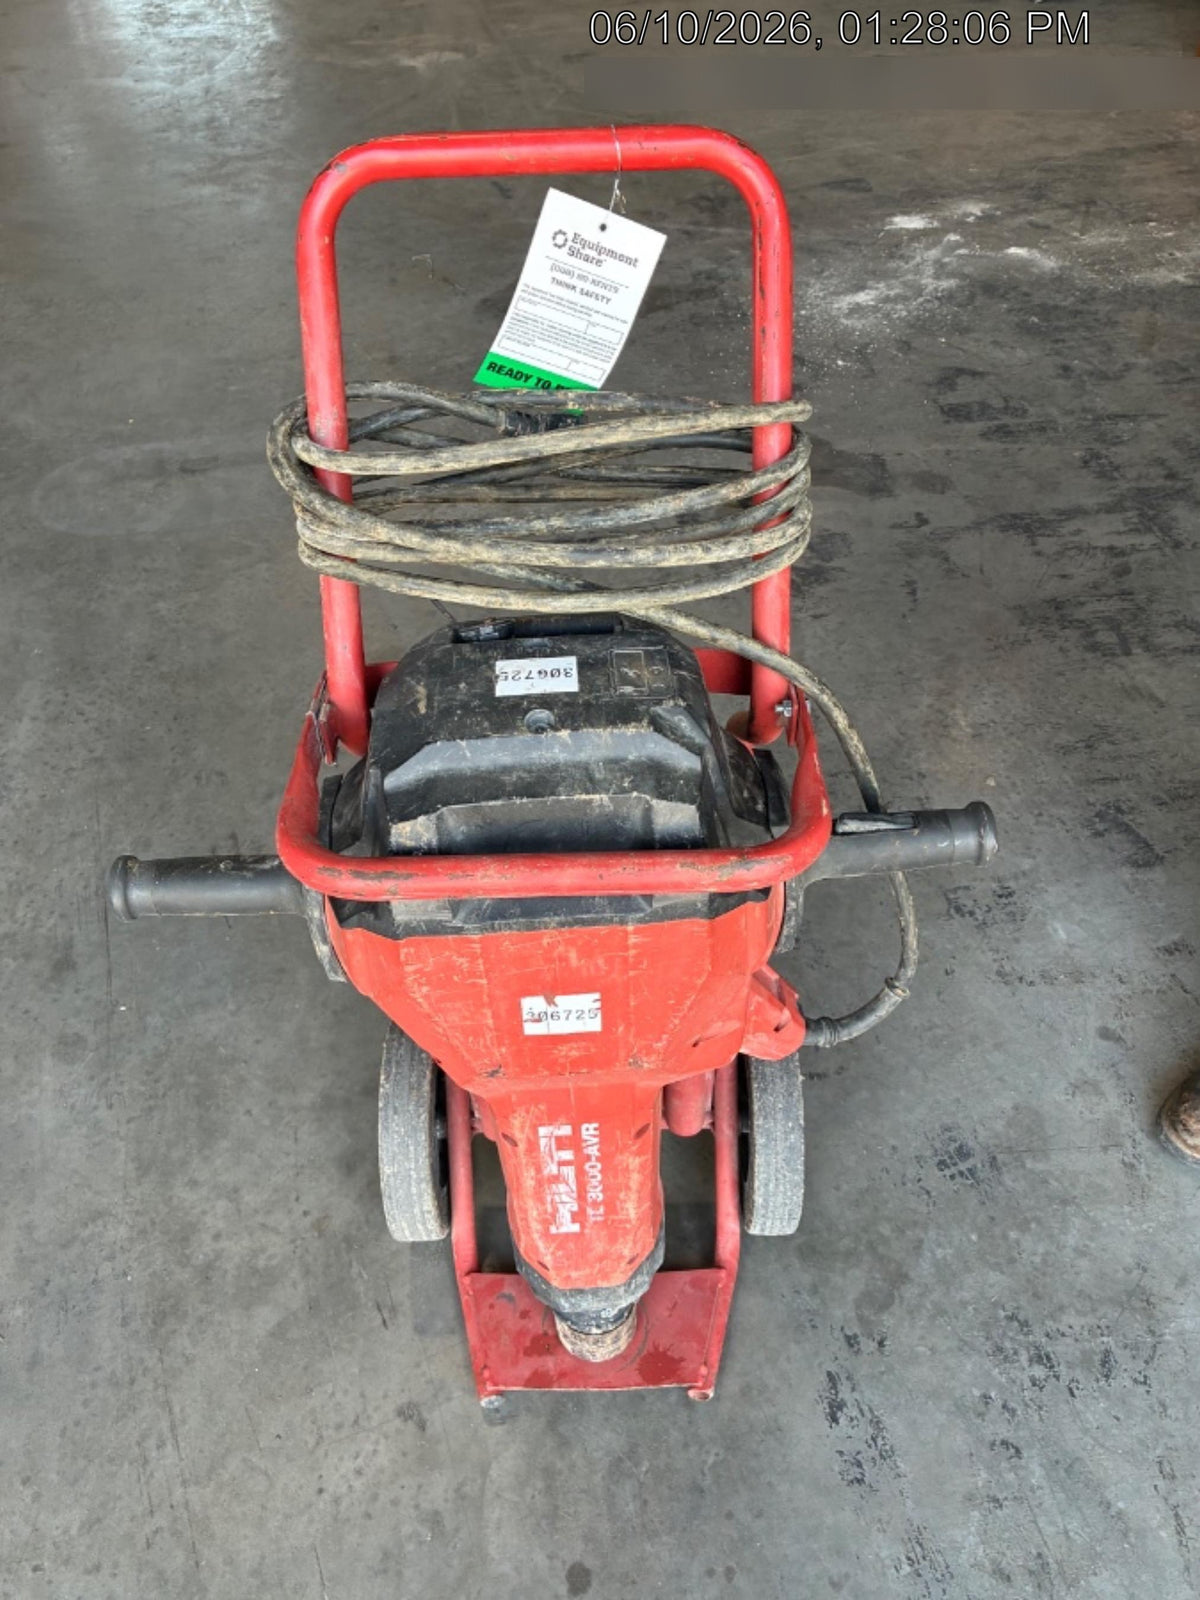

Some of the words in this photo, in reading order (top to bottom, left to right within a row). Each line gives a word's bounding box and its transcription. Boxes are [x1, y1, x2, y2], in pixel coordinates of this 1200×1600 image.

[567, 244, 604, 268] Share
[571, 231, 639, 269] Equipment
[551, 276, 577, 293] THINK
[579, 287, 612, 305] SAFETY
[486, 361, 534, 383] READY
[534, 376, 552, 390] TO
[581, 1122, 604, 1203] 3000-AVR
[538, 1124, 581, 1235] HILTI
